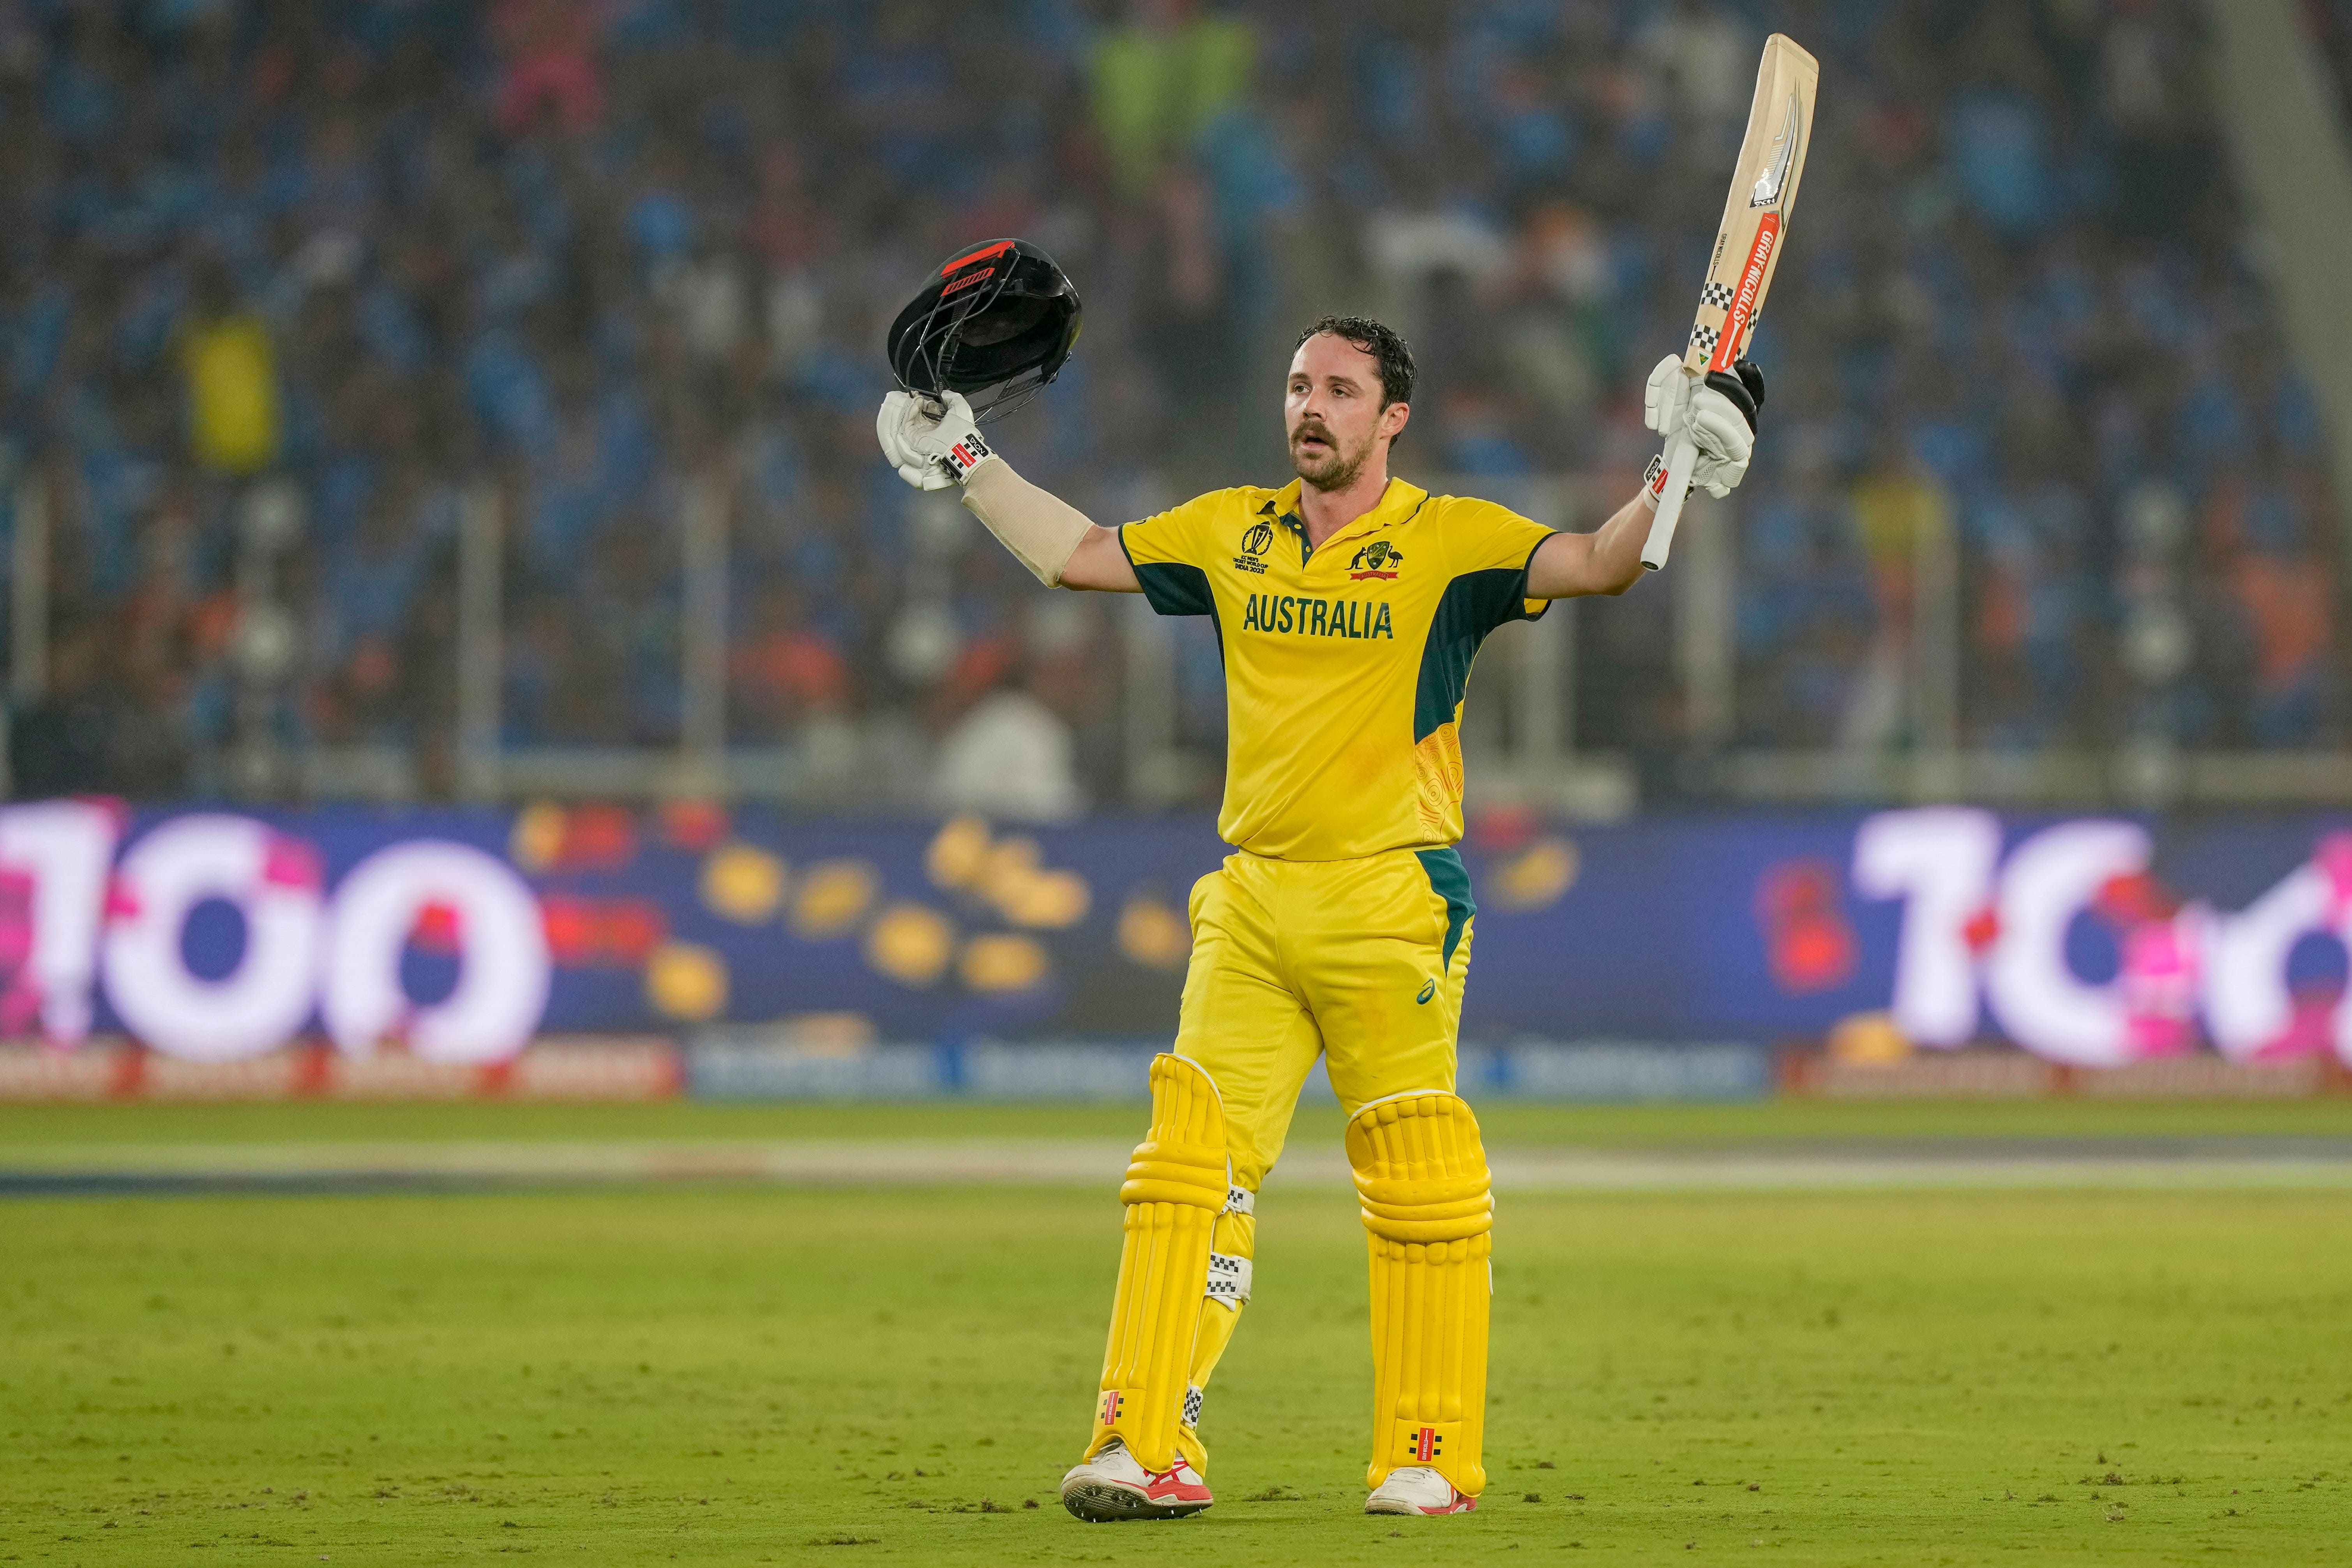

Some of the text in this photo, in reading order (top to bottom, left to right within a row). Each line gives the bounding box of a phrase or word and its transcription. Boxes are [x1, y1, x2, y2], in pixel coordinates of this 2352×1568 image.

[1733, 230, 1773, 325] GRAY-NICOLLS
[969, 437, 985, 454] NOVA
[1647, 461, 1659, 478] NOVA
[1235, 563, 1248, 571] INDIA
[1243, 593, 1393, 639] AUSTRALIA
[0, 795, 553, 1063] 100
